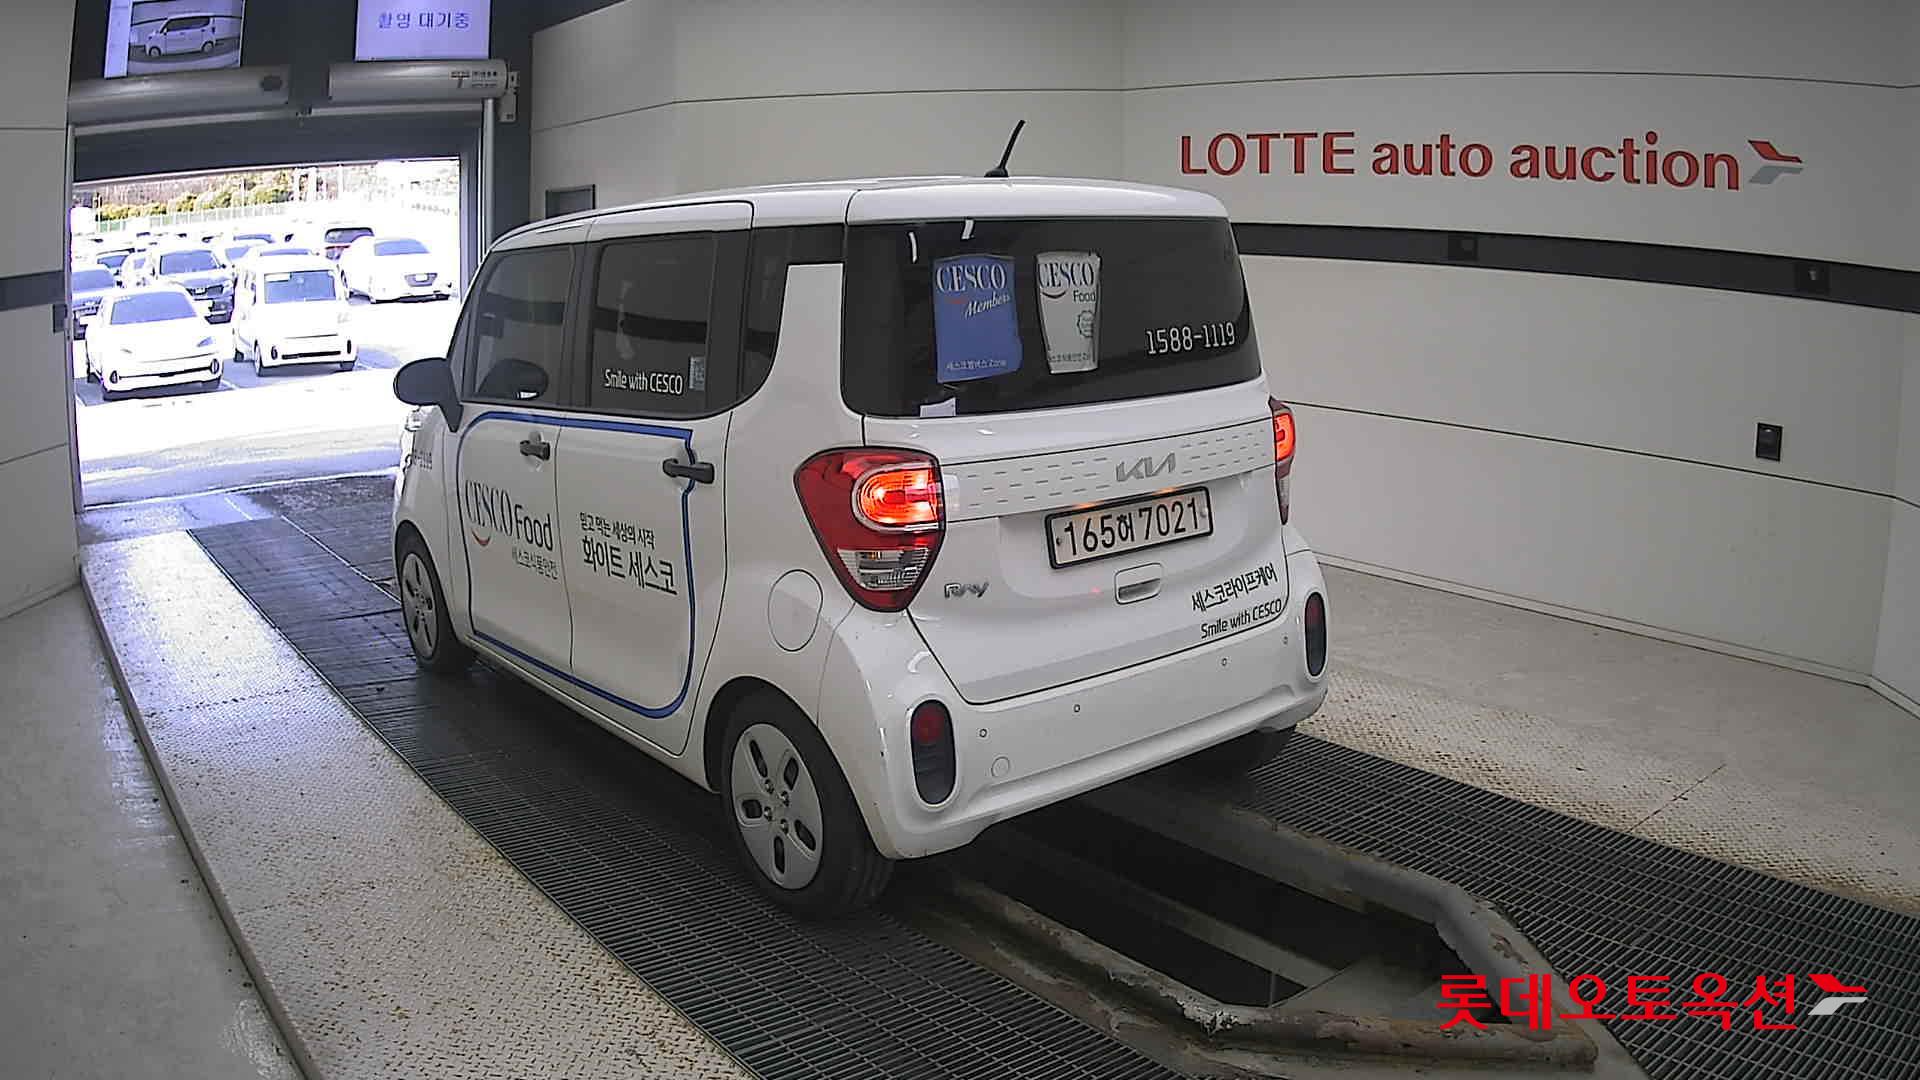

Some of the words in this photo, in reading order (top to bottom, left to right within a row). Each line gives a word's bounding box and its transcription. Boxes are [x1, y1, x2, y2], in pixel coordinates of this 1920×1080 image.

[419, 12, 469, 29] 대기중
[1180, 130, 1356, 176] LOTTE
[1371, 134, 1494, 178] auto
[1510, 131, 1740, 190] auction
[936, 263, 1006, 293] CESCO
[1038, 261, 1095, 290] CESCO
[1072, 288, 1097, 303] Food
[1146, 322, 1237, 355] 1588-1119
[604, 368, 627, 389] Smile
[628, 371, 648, 391] with
[649, 372, 683, 395] CESCO
[465, 479, 512, 536] CESCO
[514, 503, 553, 551] Food
[1063, 511, 1136, 556] 165허
[1137, 497, 1200, 540] 7021
[612, 521, 636, 544] 세상의
[638, 528, 655, 550] 시작
[582, 535, 625, 578] 화이트
[628, 551, 677, 595] 세스코
[1191, 562, 1278, 612] 세스코라이프케어
[1201, 618, 1228, 639] Smile
[1229, 608, 1251, 629] with
[1252, 598, 1282, 621] CESCO
